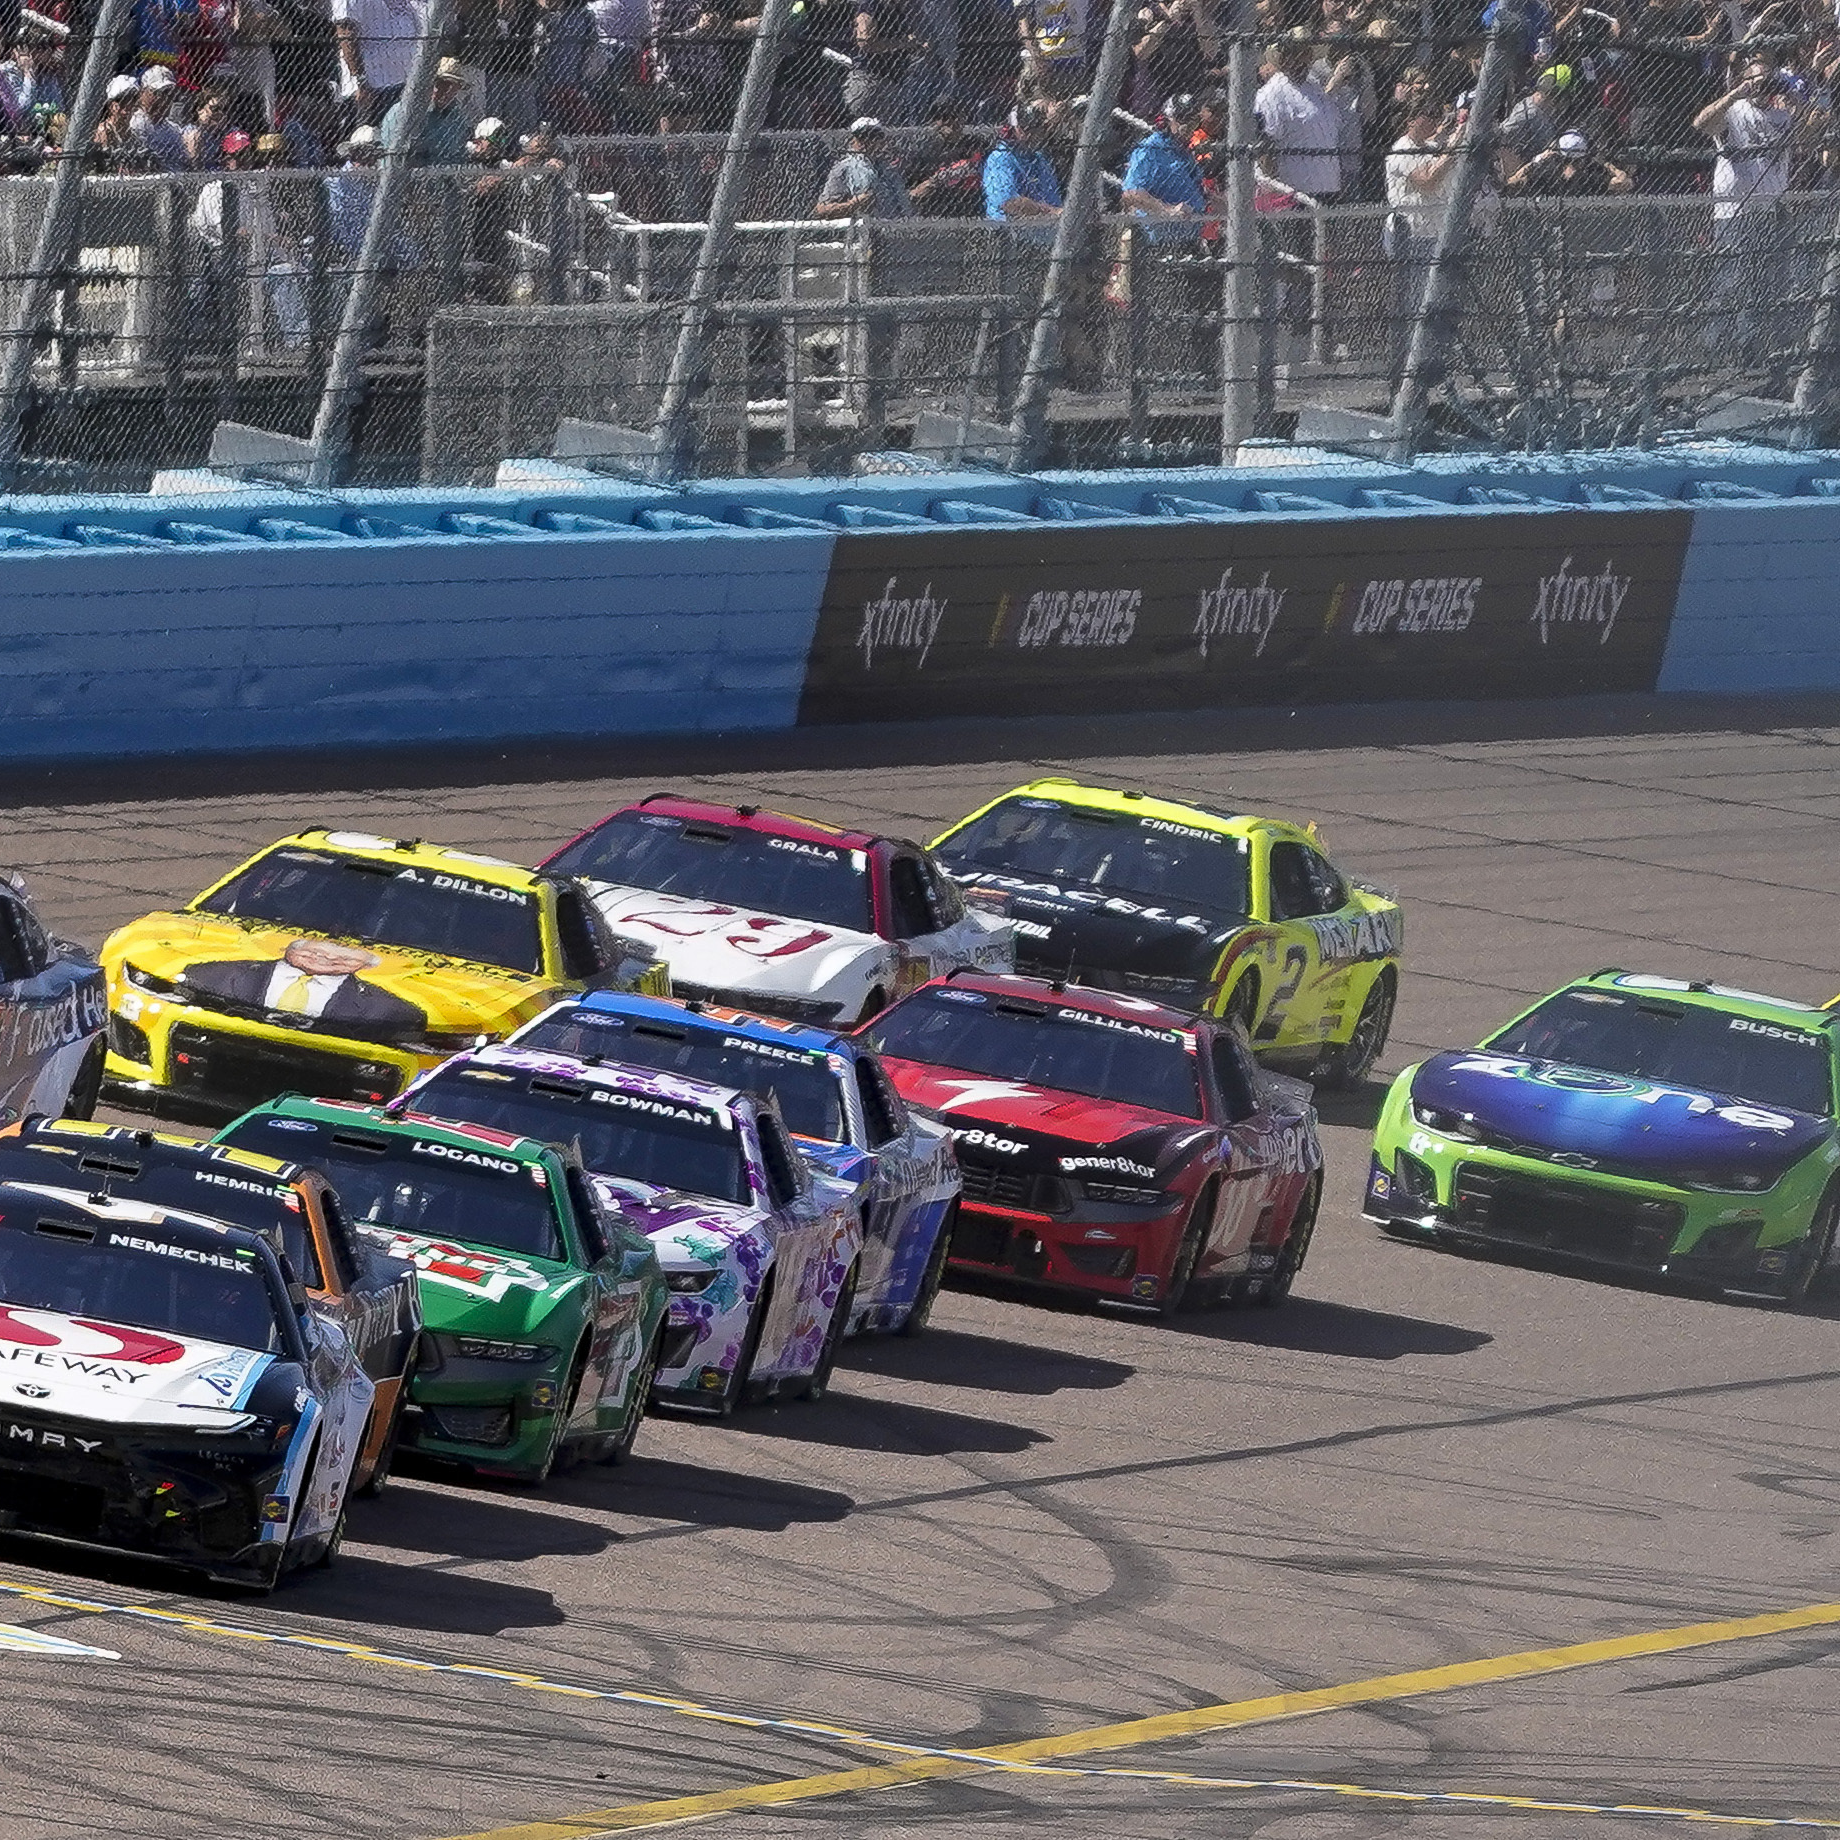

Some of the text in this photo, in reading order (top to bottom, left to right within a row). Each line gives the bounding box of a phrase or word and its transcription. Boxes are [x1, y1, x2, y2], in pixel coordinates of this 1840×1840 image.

[1193, 566, 1285, 658] xfinity
[1530, 557, 1630, 644] xfinity
[856, 577, 948, 669] xfinity
[1141, 817, 1222, 845] CINDRIC
[767, 838, 838, 861] GRALA
[432, 875, 527, 905] DILLON
[936, 863, 1215, 934] URACELL
[1058, 1008, 1179, 1043] GILLILAND
[1728, 1019, 1817, 1045] BUSCH
[723, 1037, 816, 1064] PREECE
[591, 1089, 712, 1124] BOWMAN
[413, 1140, 520, 1174] LOGANO
[952, 1129, 1029, 1155] r8tor
[1060, 1155, 1156, 1177] gener8tor
[109, 1234, 253, 1272] NEMECHEK
